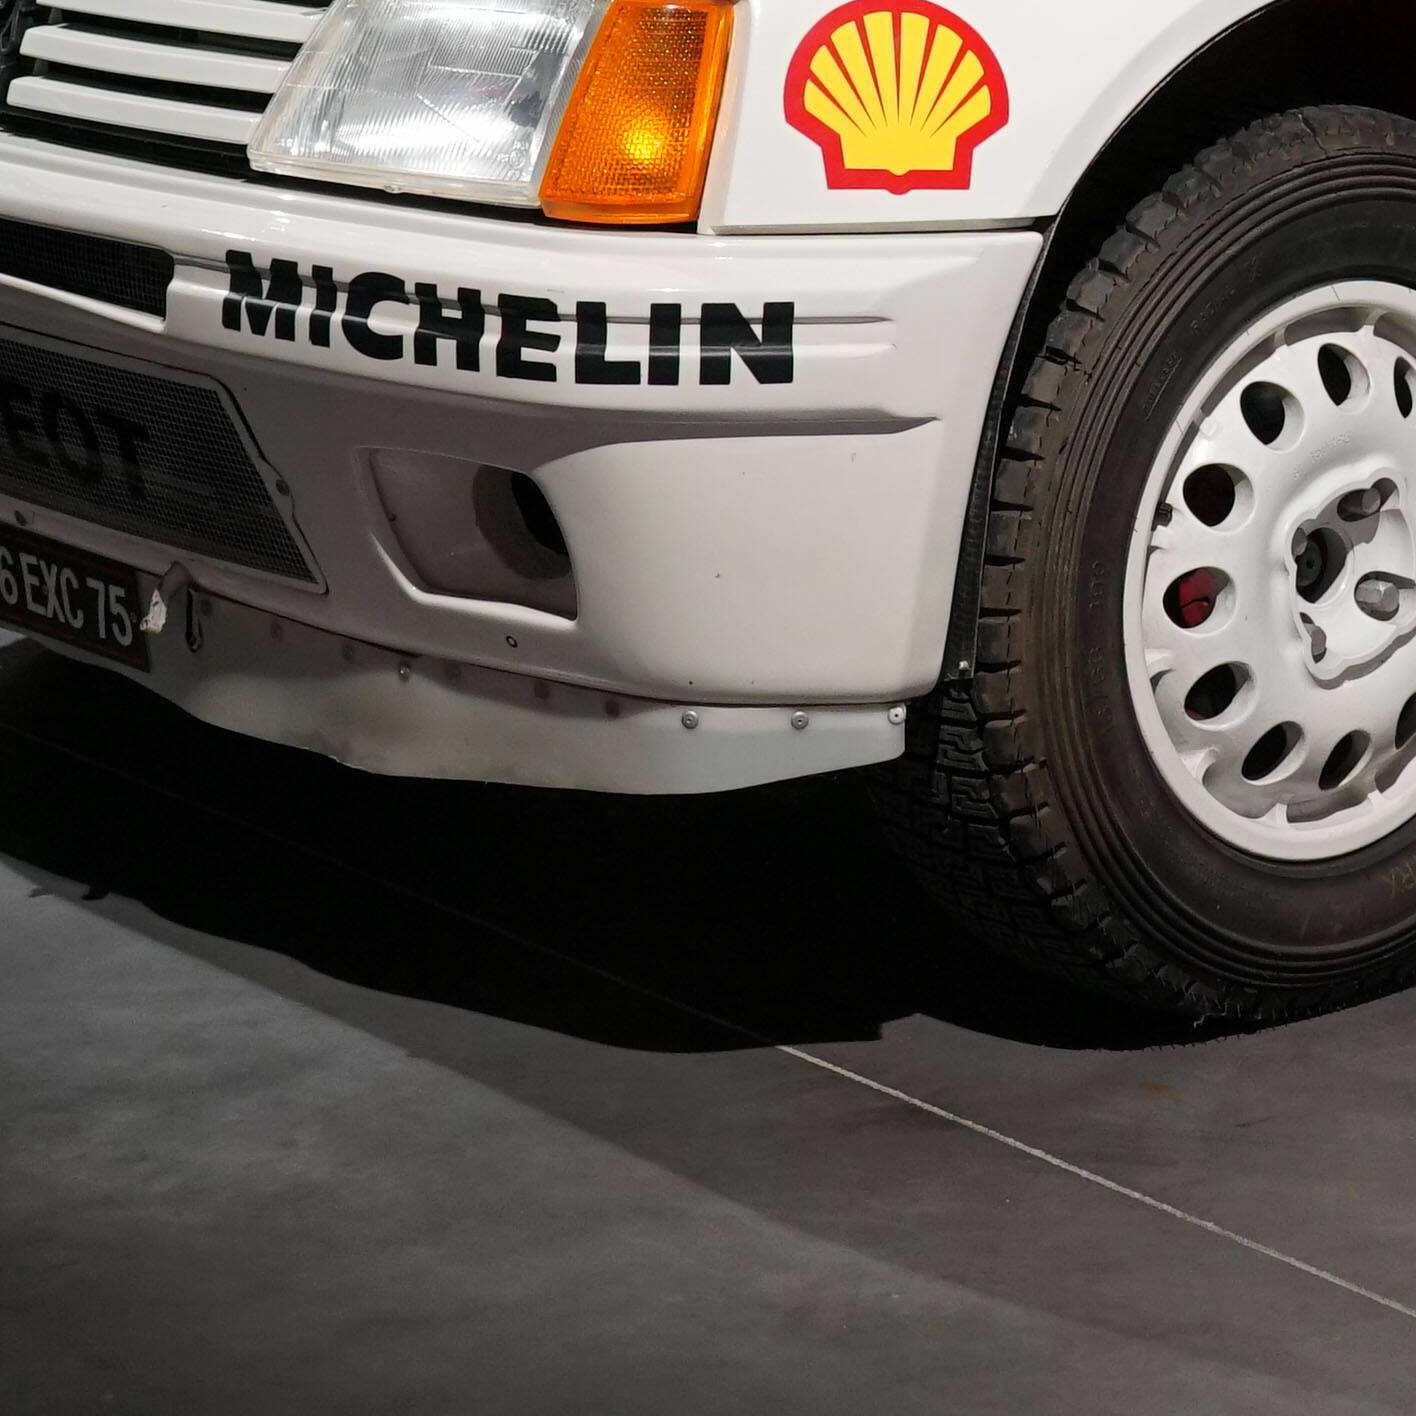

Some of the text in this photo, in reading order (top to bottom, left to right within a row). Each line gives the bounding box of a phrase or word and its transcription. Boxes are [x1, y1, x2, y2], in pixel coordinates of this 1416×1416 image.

[222, 249, 795, 386] MICHELIN
[19, 552, 84, 629] EXC
[86, 577, 133, 647] 75
